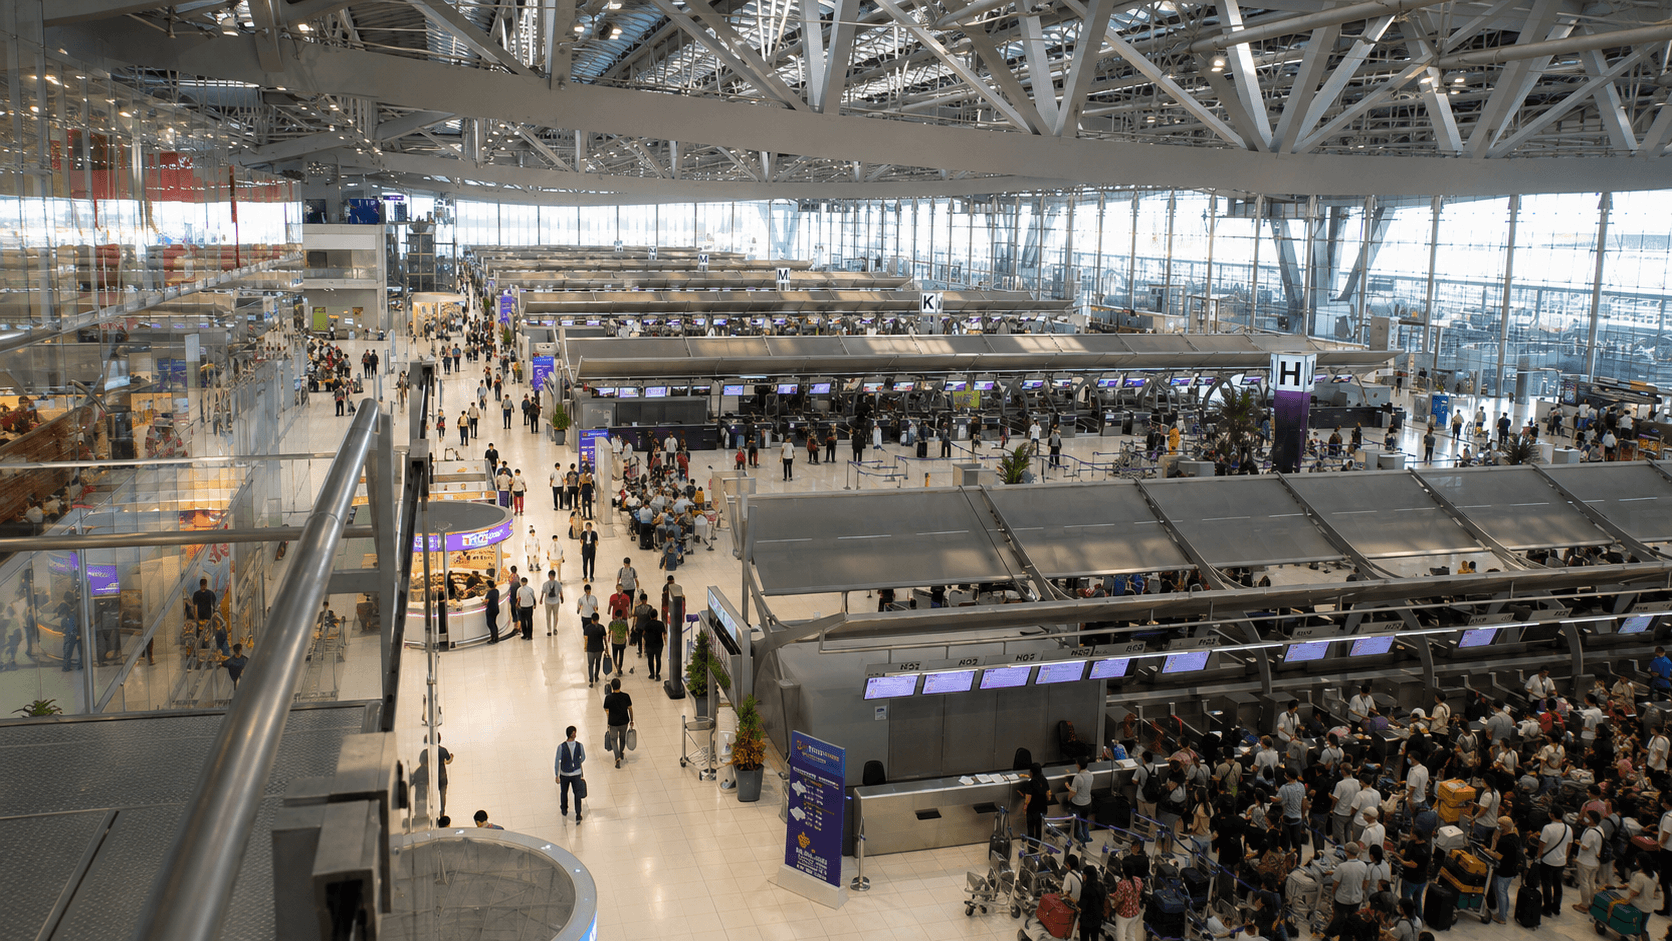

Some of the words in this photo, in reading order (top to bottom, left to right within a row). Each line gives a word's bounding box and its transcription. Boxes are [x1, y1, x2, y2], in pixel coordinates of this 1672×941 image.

[778, 269, 788, 281] M
[923, 295, 934, 310] K
[1279, 361, 1301, 386] H
